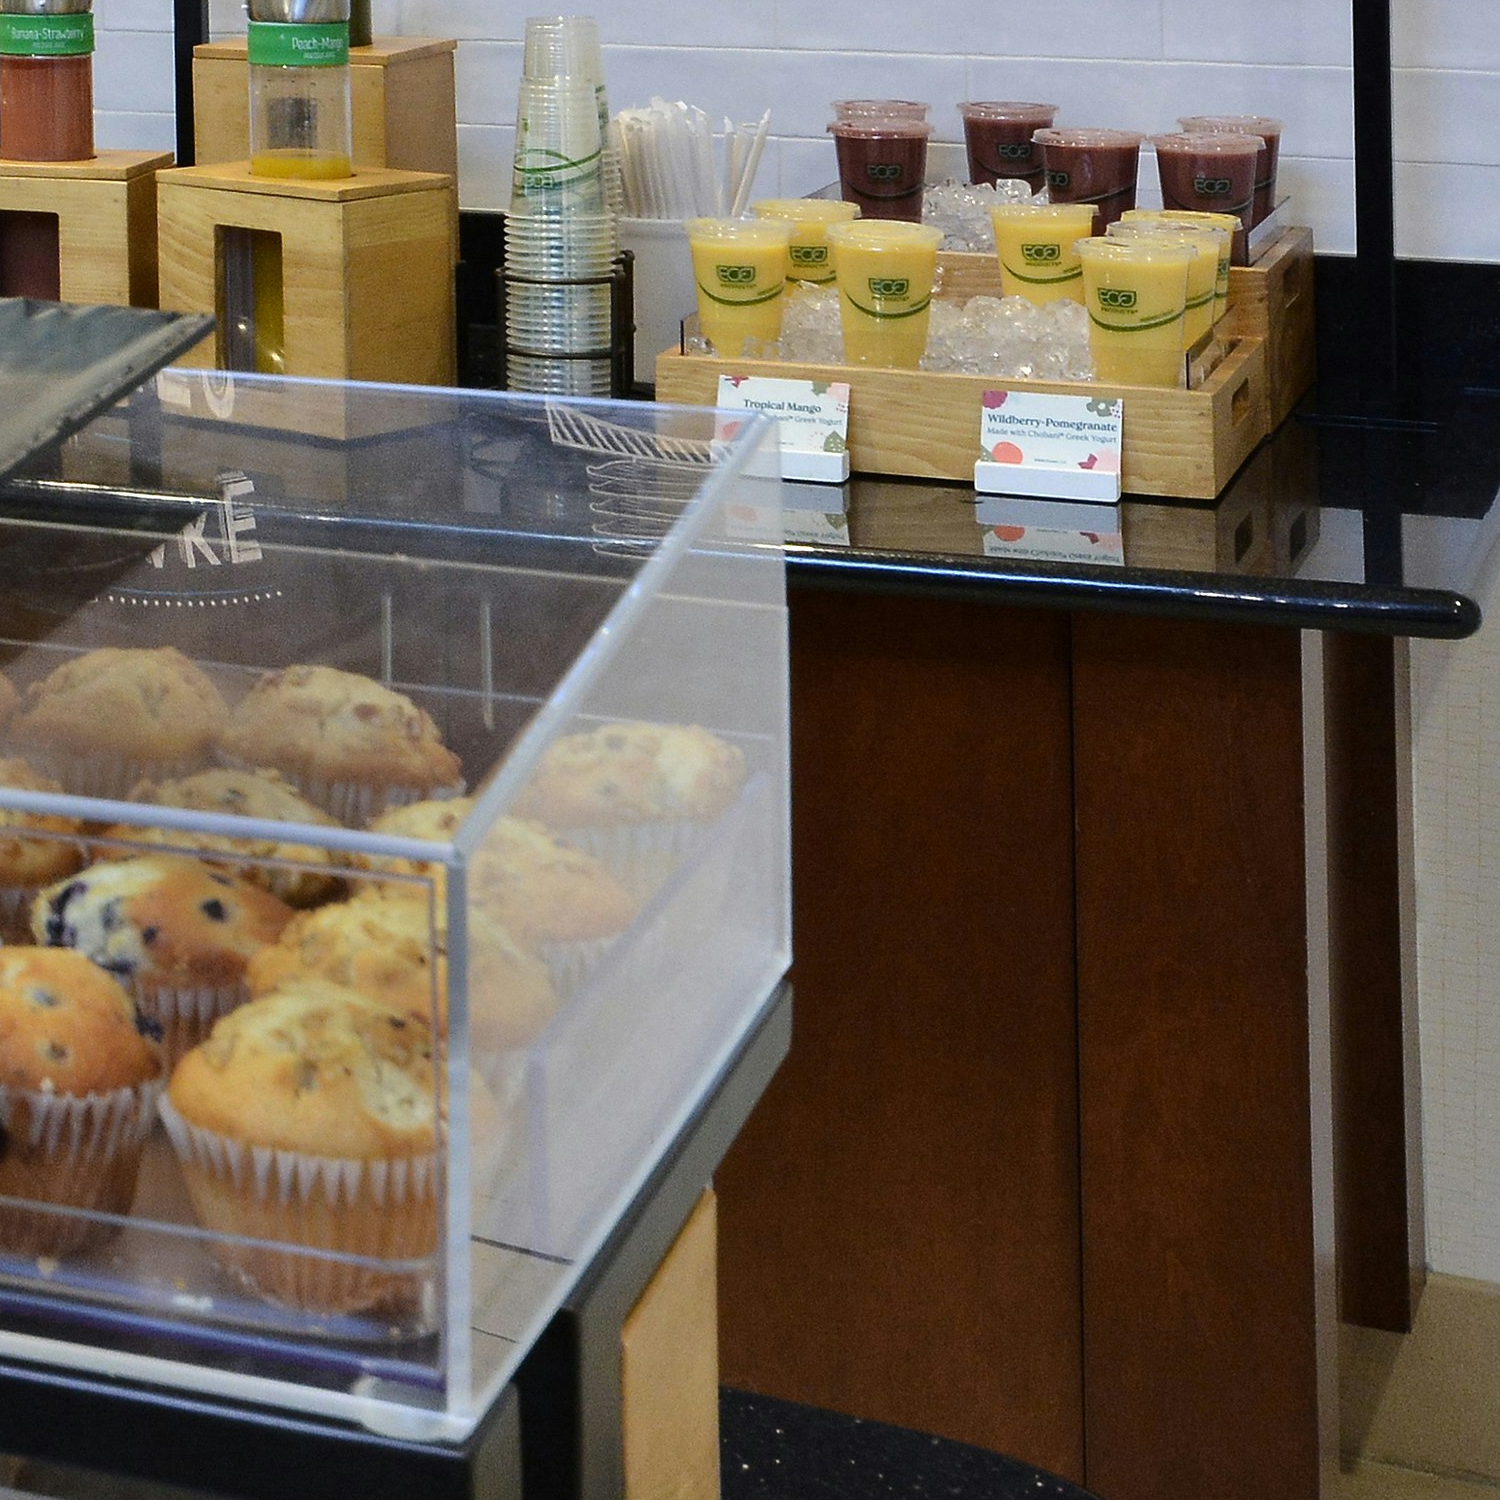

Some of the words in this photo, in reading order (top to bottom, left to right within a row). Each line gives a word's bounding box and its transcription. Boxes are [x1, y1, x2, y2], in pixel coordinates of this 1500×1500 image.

[790, 247, 827, 262] ECO
[1022, 245, 1060, 261] ECO
[717, 267, 755, 282] ECO
[869, 279, 908, 296] ECO
[1099, 288, 1137, 307] ECO
[743, 398, 785, 411] Tropical
[787, 402, 822, 414] Mango
[987, 413, 1117, 432] Wildberry-Pomegranate
[987, 427, 1008, 436] Made
[1065, 433, 1089, 441] Greek
